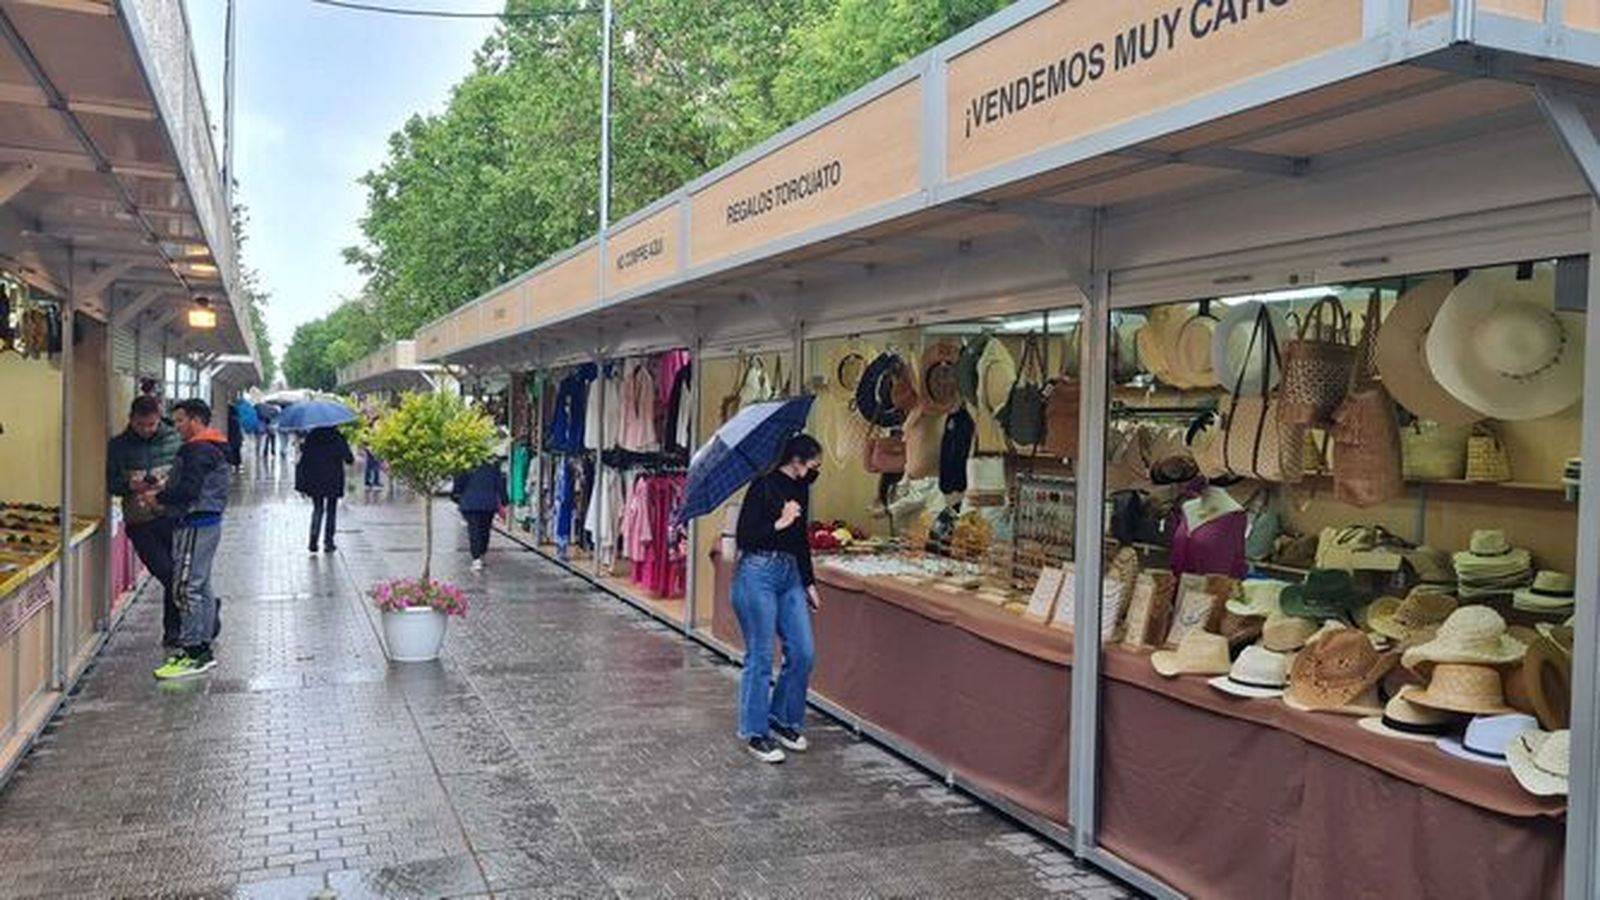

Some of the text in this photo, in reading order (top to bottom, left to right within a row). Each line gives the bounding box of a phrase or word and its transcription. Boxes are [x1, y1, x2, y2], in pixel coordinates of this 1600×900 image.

[1113, 8, 1183, 71] MUY
[1189, 0, 1288, 39] CA
[727, 160, 841, 225] REGALOS TORCUATO
